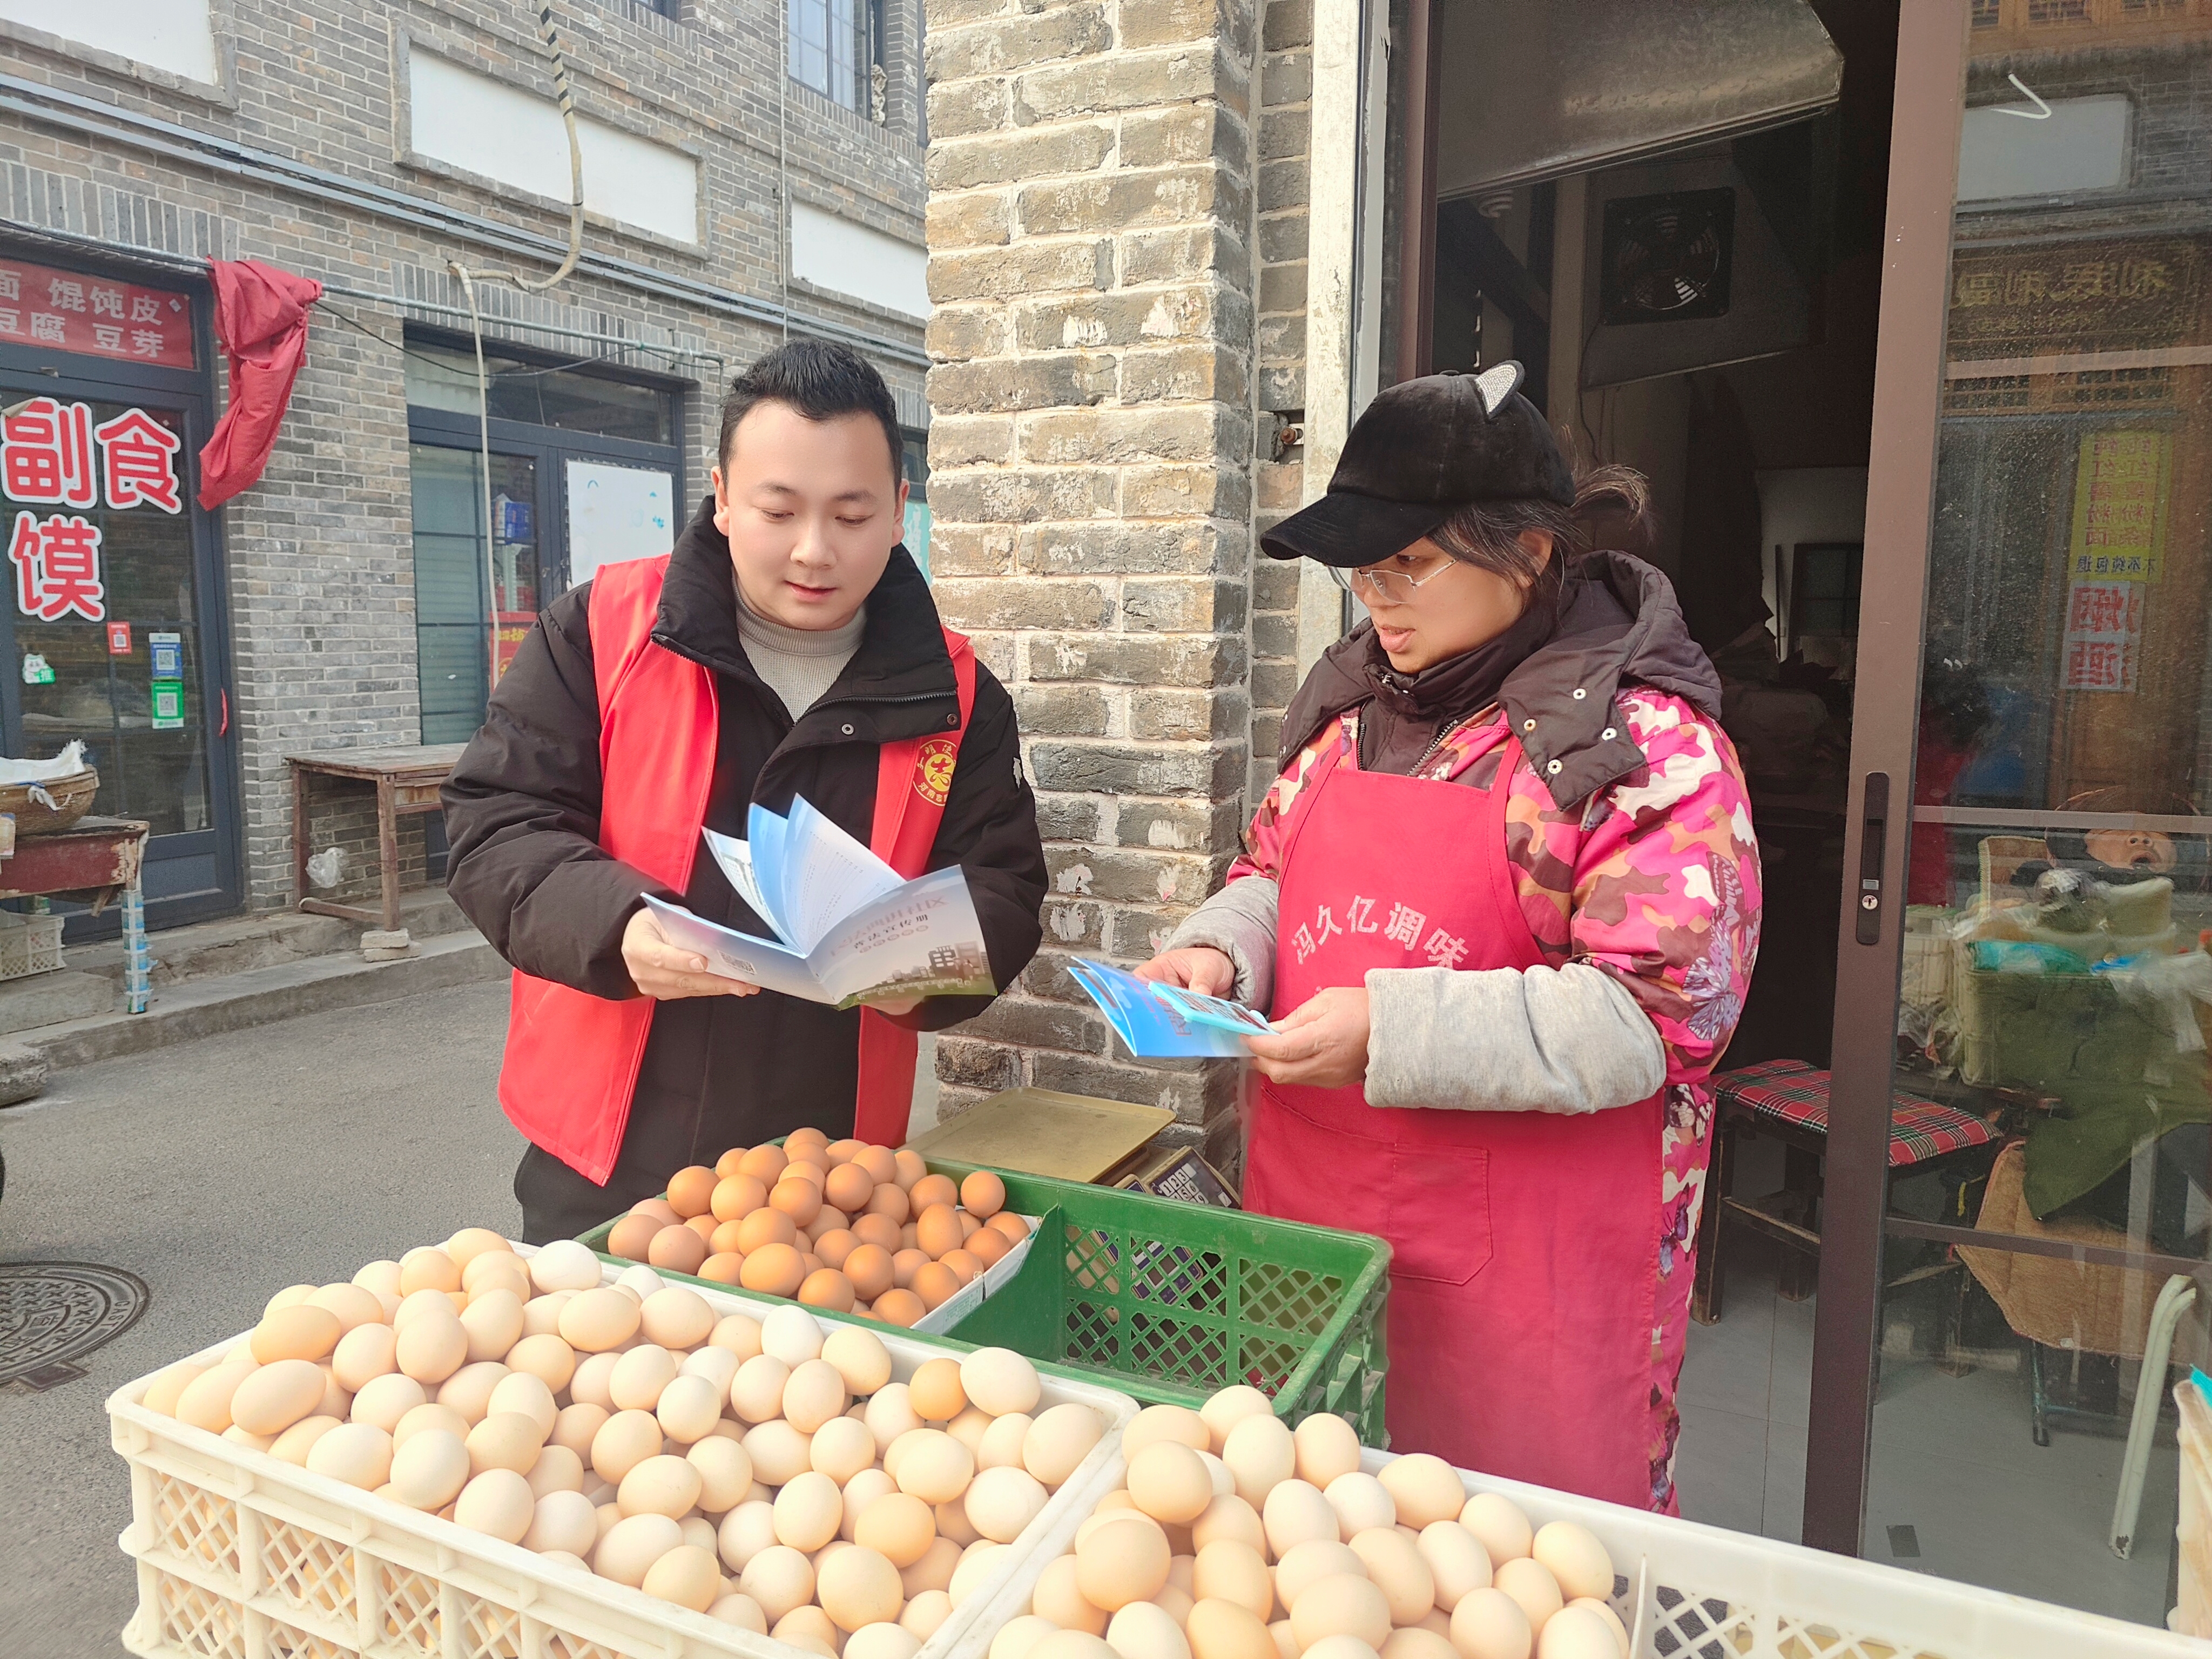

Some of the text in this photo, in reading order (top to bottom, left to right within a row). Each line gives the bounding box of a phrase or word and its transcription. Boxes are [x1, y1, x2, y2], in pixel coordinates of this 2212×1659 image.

[48, 277, 163, 326] 馄饨皮
[0, 307, 164, 358] 豆腐 豆芽
[3, 396, 182, 514] 副食
[8, 510, 105, 622] 馍
[1291, 895, 1469, 969] 冯久亿调味
[1164, 1172, 1186, 1193] 1 2 3
[1188, 1184, 1196, 1192] 6
